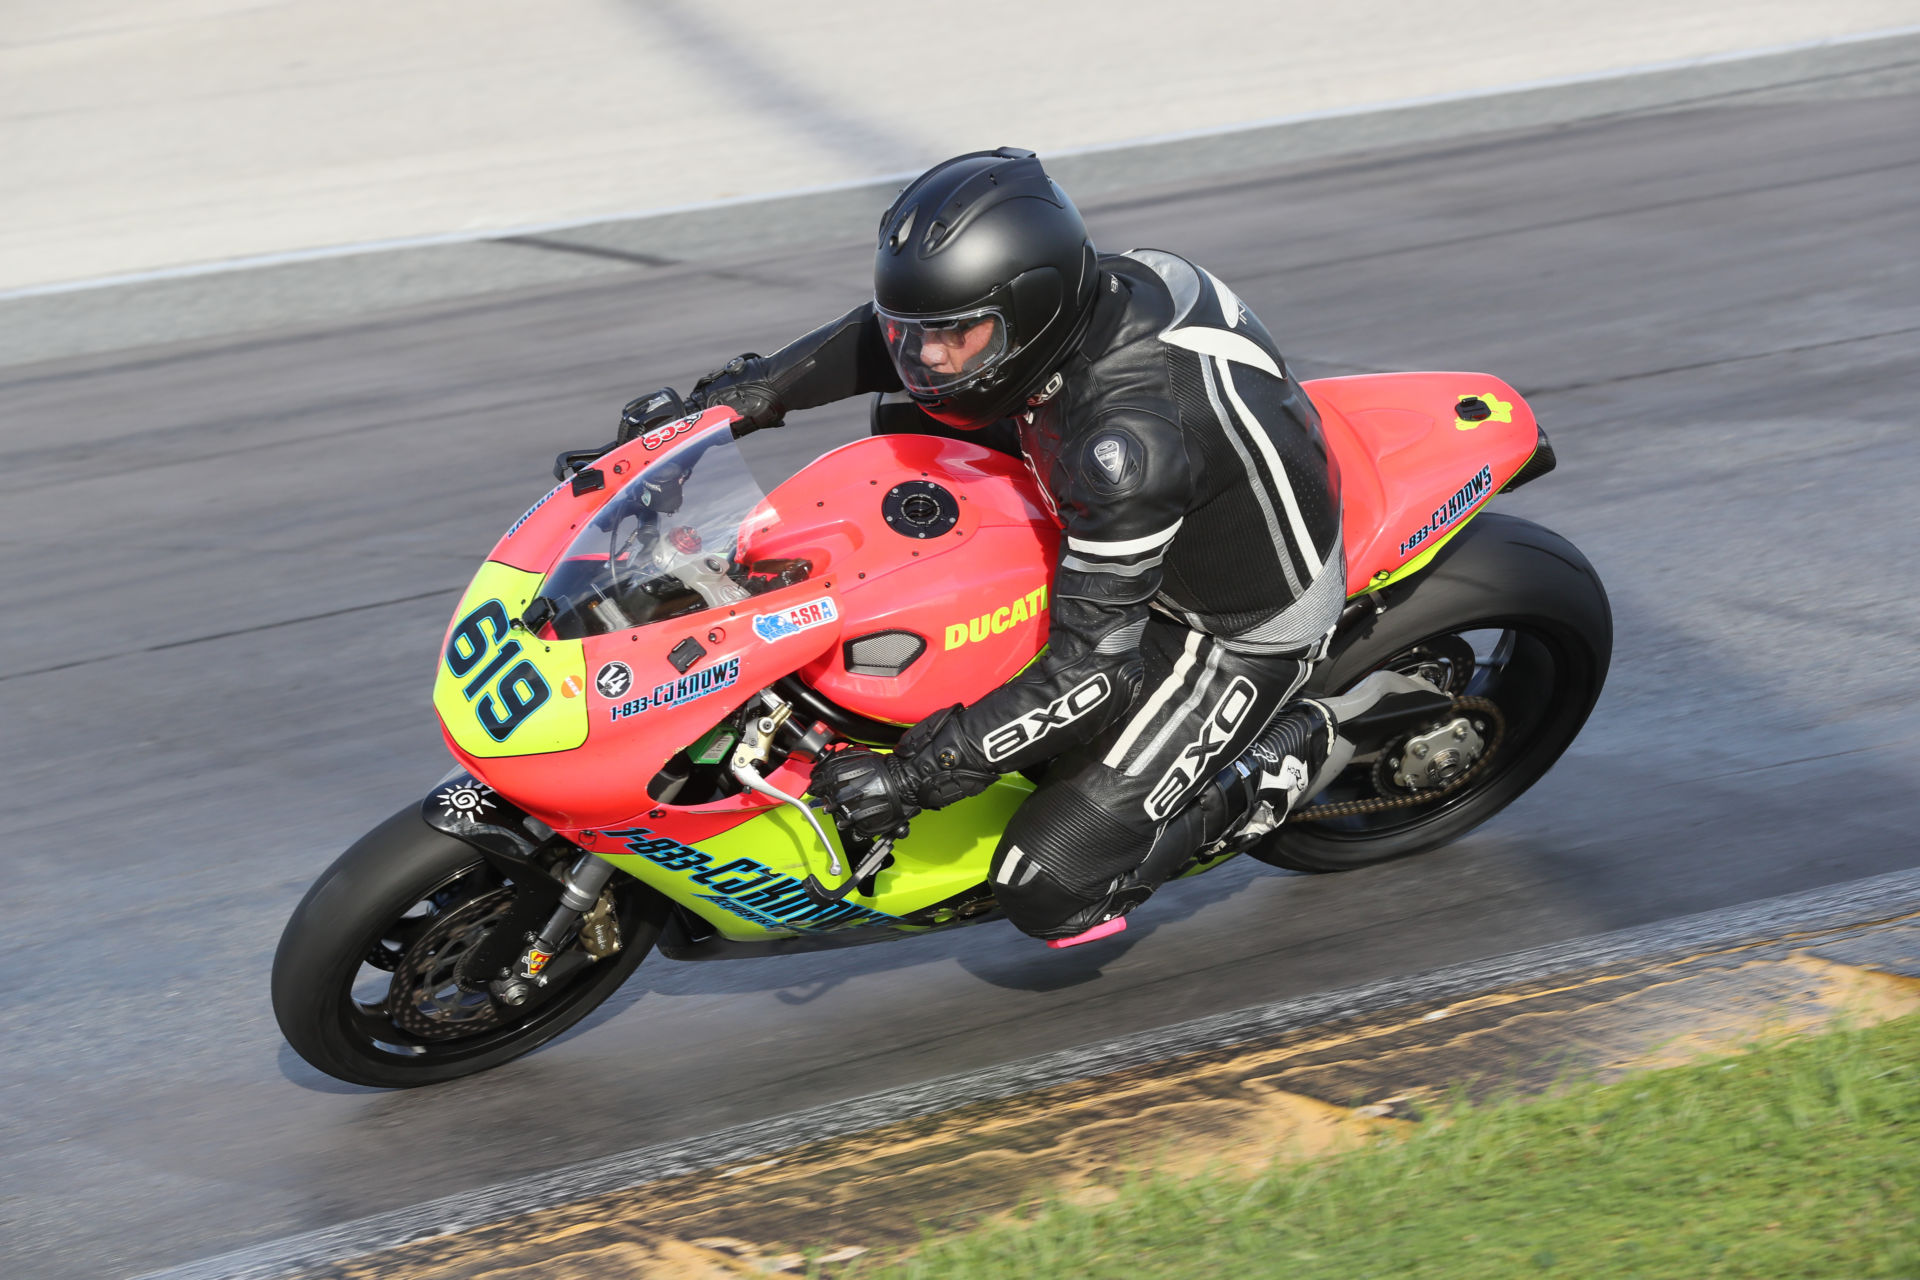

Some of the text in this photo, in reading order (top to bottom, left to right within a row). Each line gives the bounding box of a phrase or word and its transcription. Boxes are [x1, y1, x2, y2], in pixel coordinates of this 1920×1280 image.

[790, 601, 833, 626] ASRA
[944, 583, 1048, 652] DUCATI
[446, 598, 552, 743] 619
